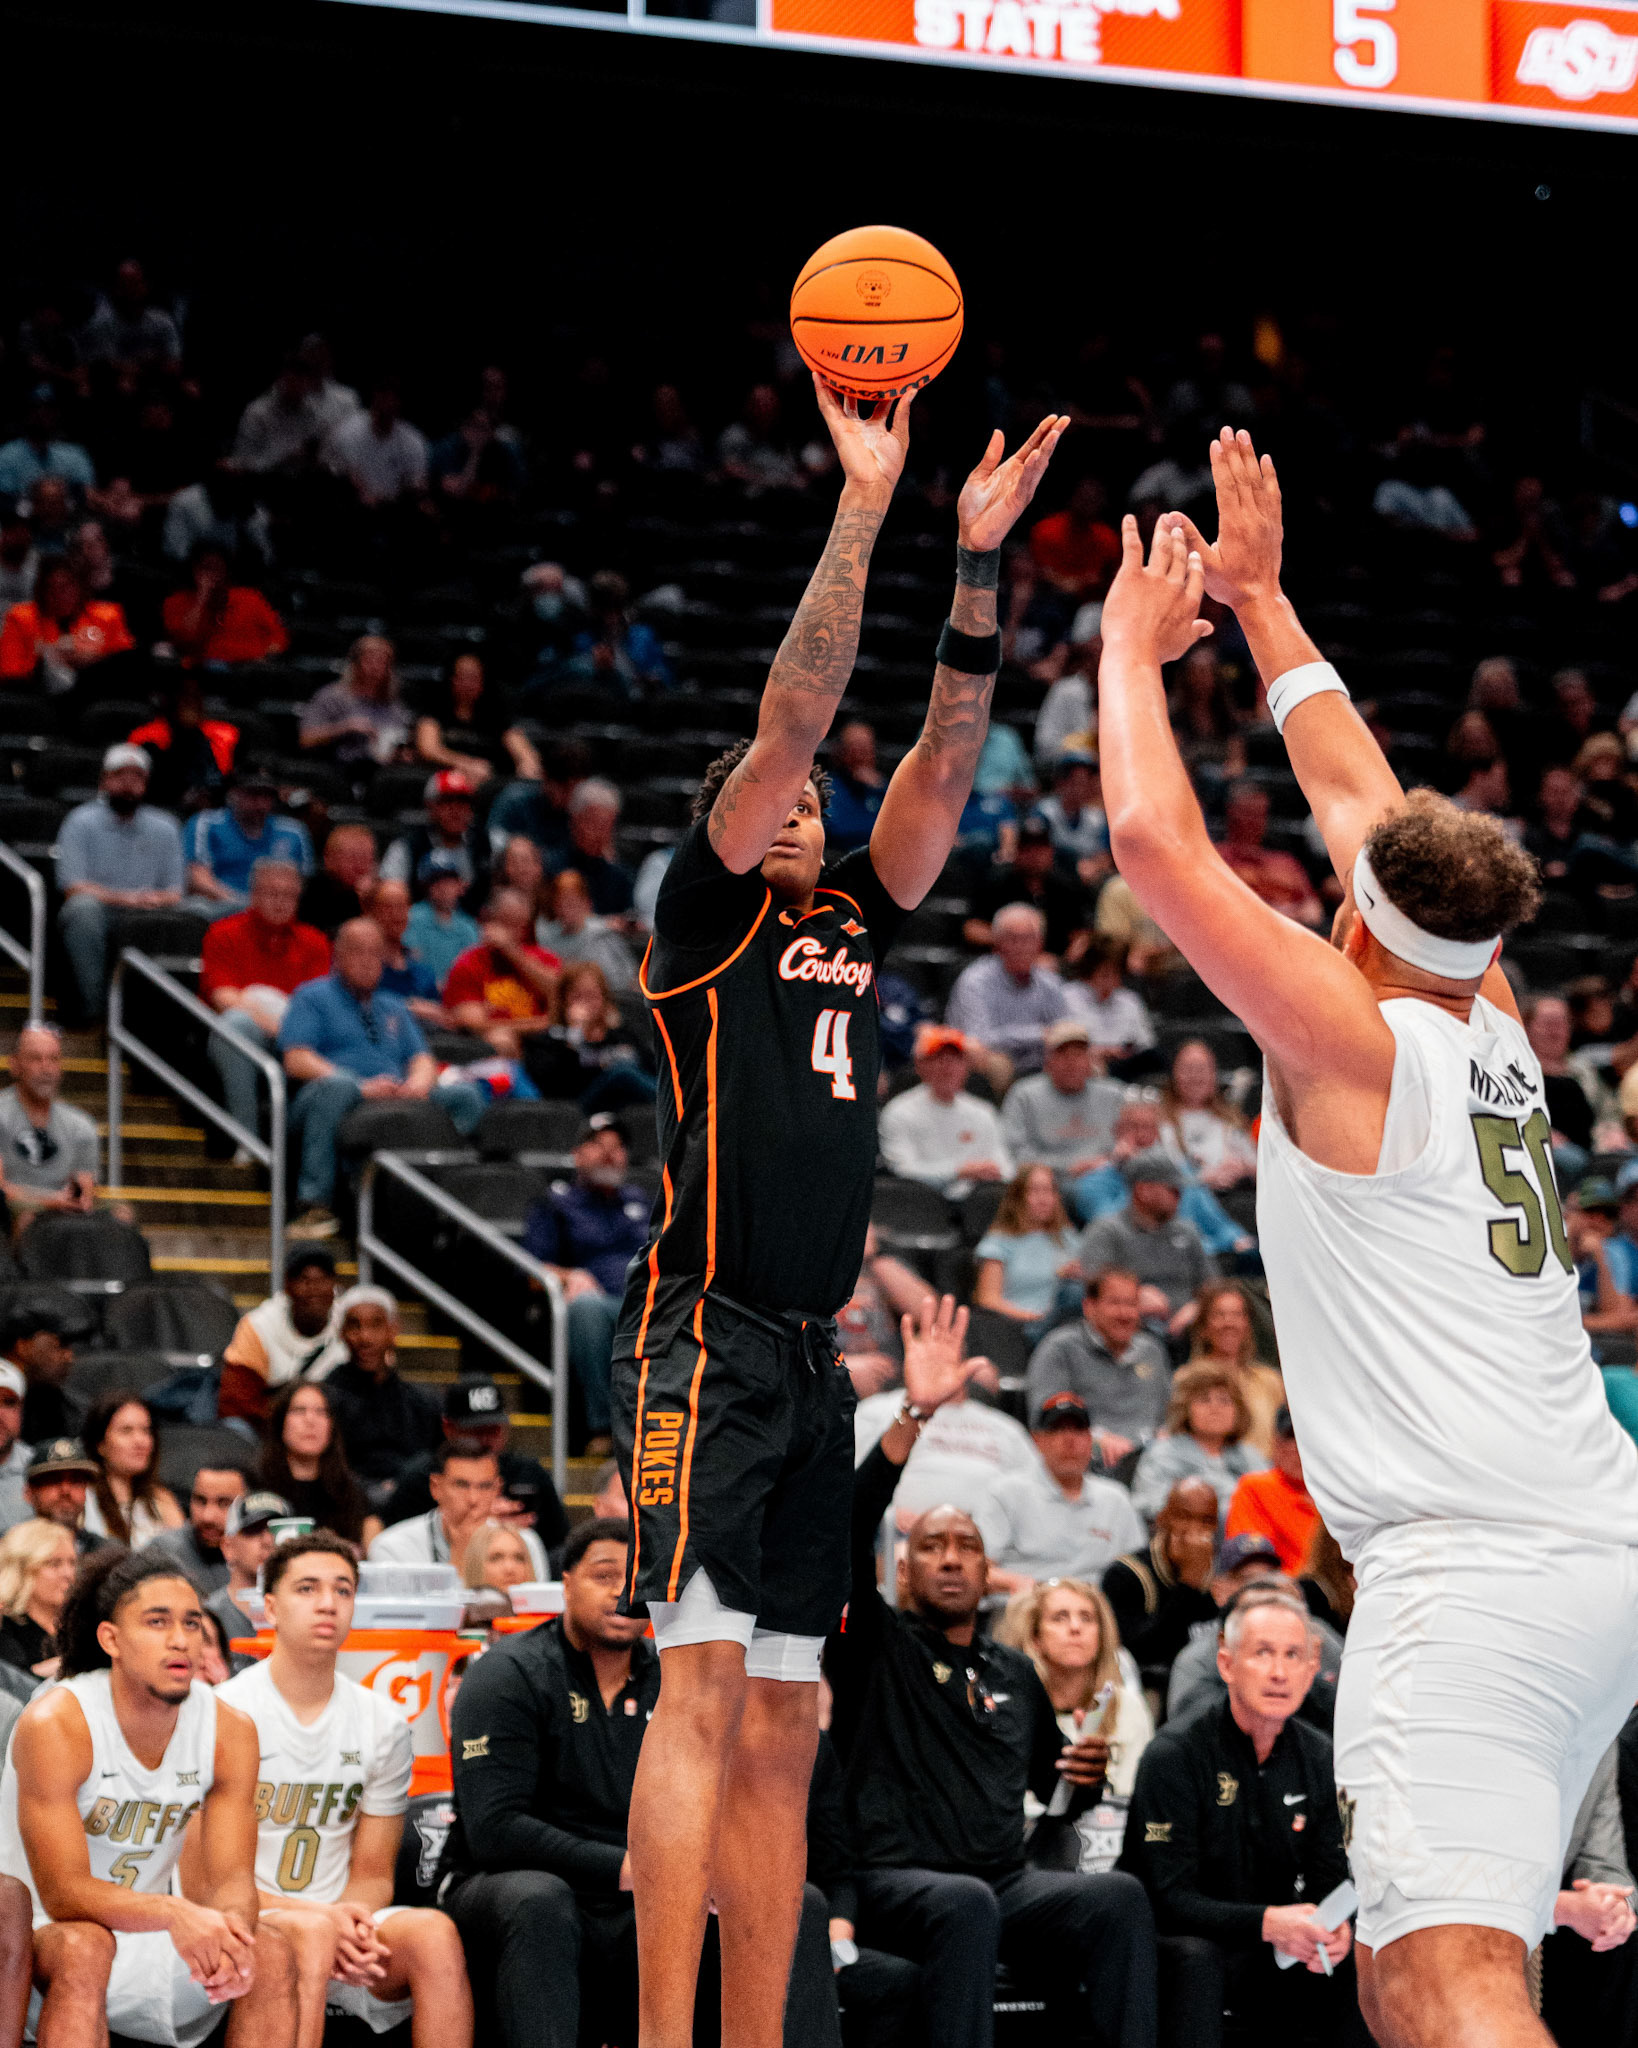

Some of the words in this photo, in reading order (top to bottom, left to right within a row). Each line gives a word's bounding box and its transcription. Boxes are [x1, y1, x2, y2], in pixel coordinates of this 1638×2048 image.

[914, 0, 1101, 64] STATE
[1332, 0, 1399, 88] 5
[841, 343, 909, 364] EVO
[811, 1008, 857, 1101] 4
[1469, 1107, 1576, 1278] 50
[639, 1411, 685, 1506] POKES
[255, 1782, 364, 1828] BUFFS
[109, 1850, 154, 1892] 5
[276, 1826, 321, 1893] 0
